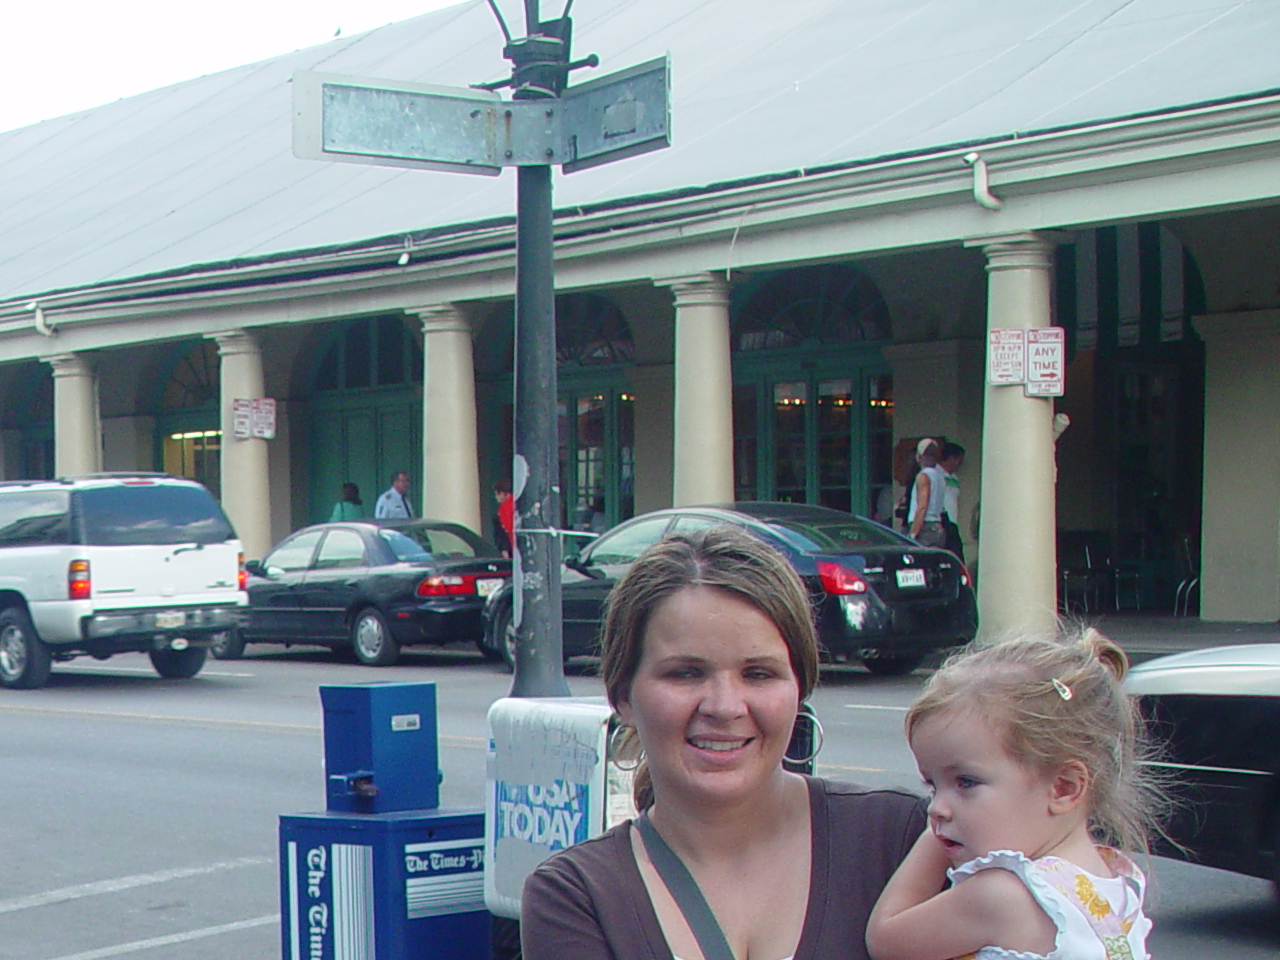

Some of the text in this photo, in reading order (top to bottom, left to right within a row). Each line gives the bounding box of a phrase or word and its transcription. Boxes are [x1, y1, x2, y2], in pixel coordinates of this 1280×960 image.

[1034, 347, 1057, 357] ANY
[1032, 361, 1058, 371] TIME
[500, 801, 583, 848] TODAY
[307, 845, 327, 898] The
[404, 855, 429, 873] The
